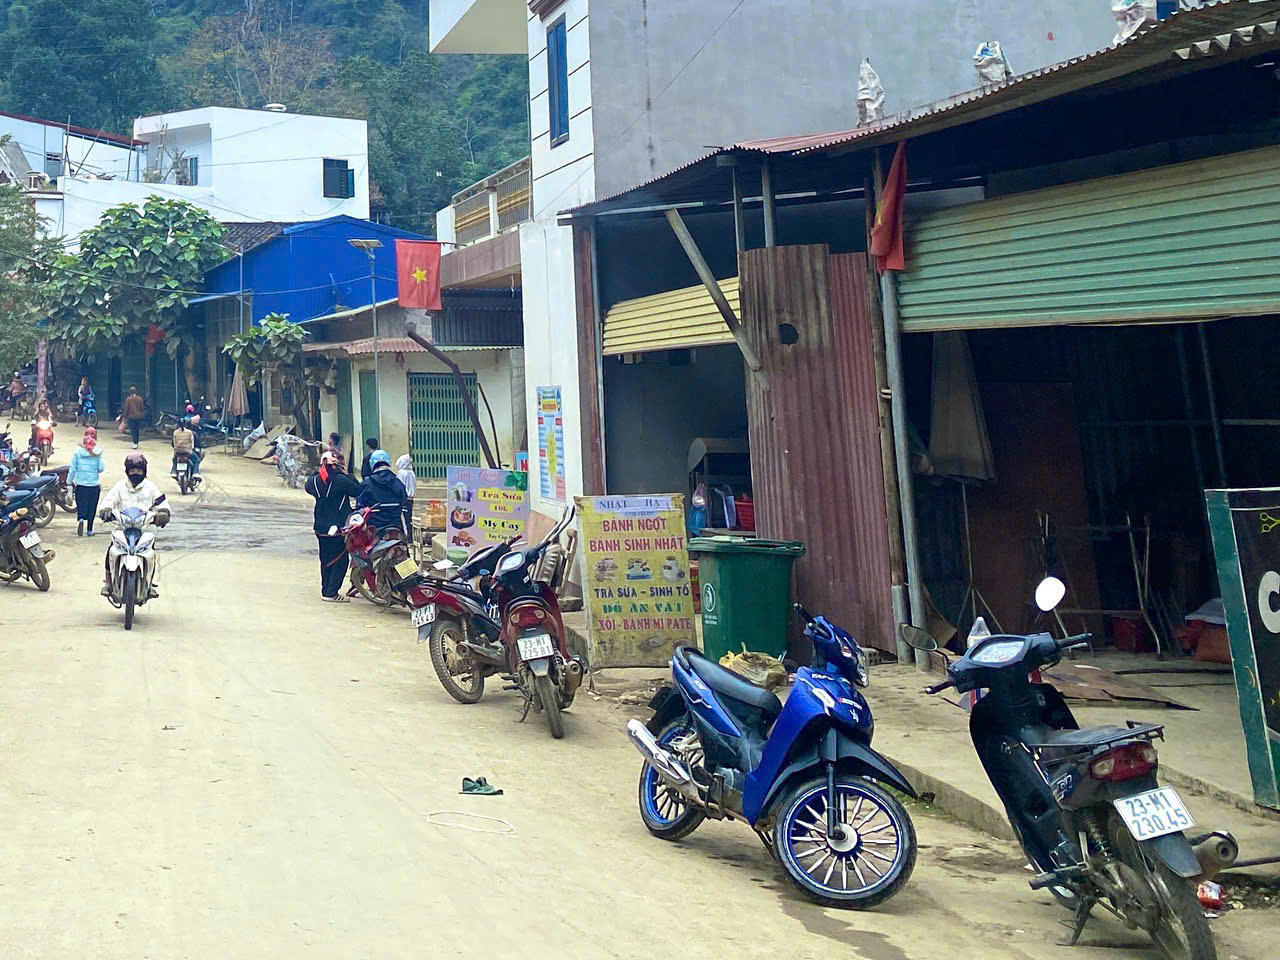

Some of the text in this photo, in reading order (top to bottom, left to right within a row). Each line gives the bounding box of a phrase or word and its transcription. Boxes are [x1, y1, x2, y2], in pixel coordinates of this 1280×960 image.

[602, 517, 667, 533] BÁNH NGỌT
[589, 534, 684, 552] BÁNH SINH NHẬT
[594, 586, 614, 599] TRÀ
[649, 586, 673, 597] SINH
[676, 583, 689, 597] TỐ
[598, 616, 616, 630] XÔI
[623, 617, 650, 630] BÁNH
[667, 617, 692, 630] PATE
[1125, 791, 1172, 817] 23-M1
[1131, 808, 1189, 837] 230.45
